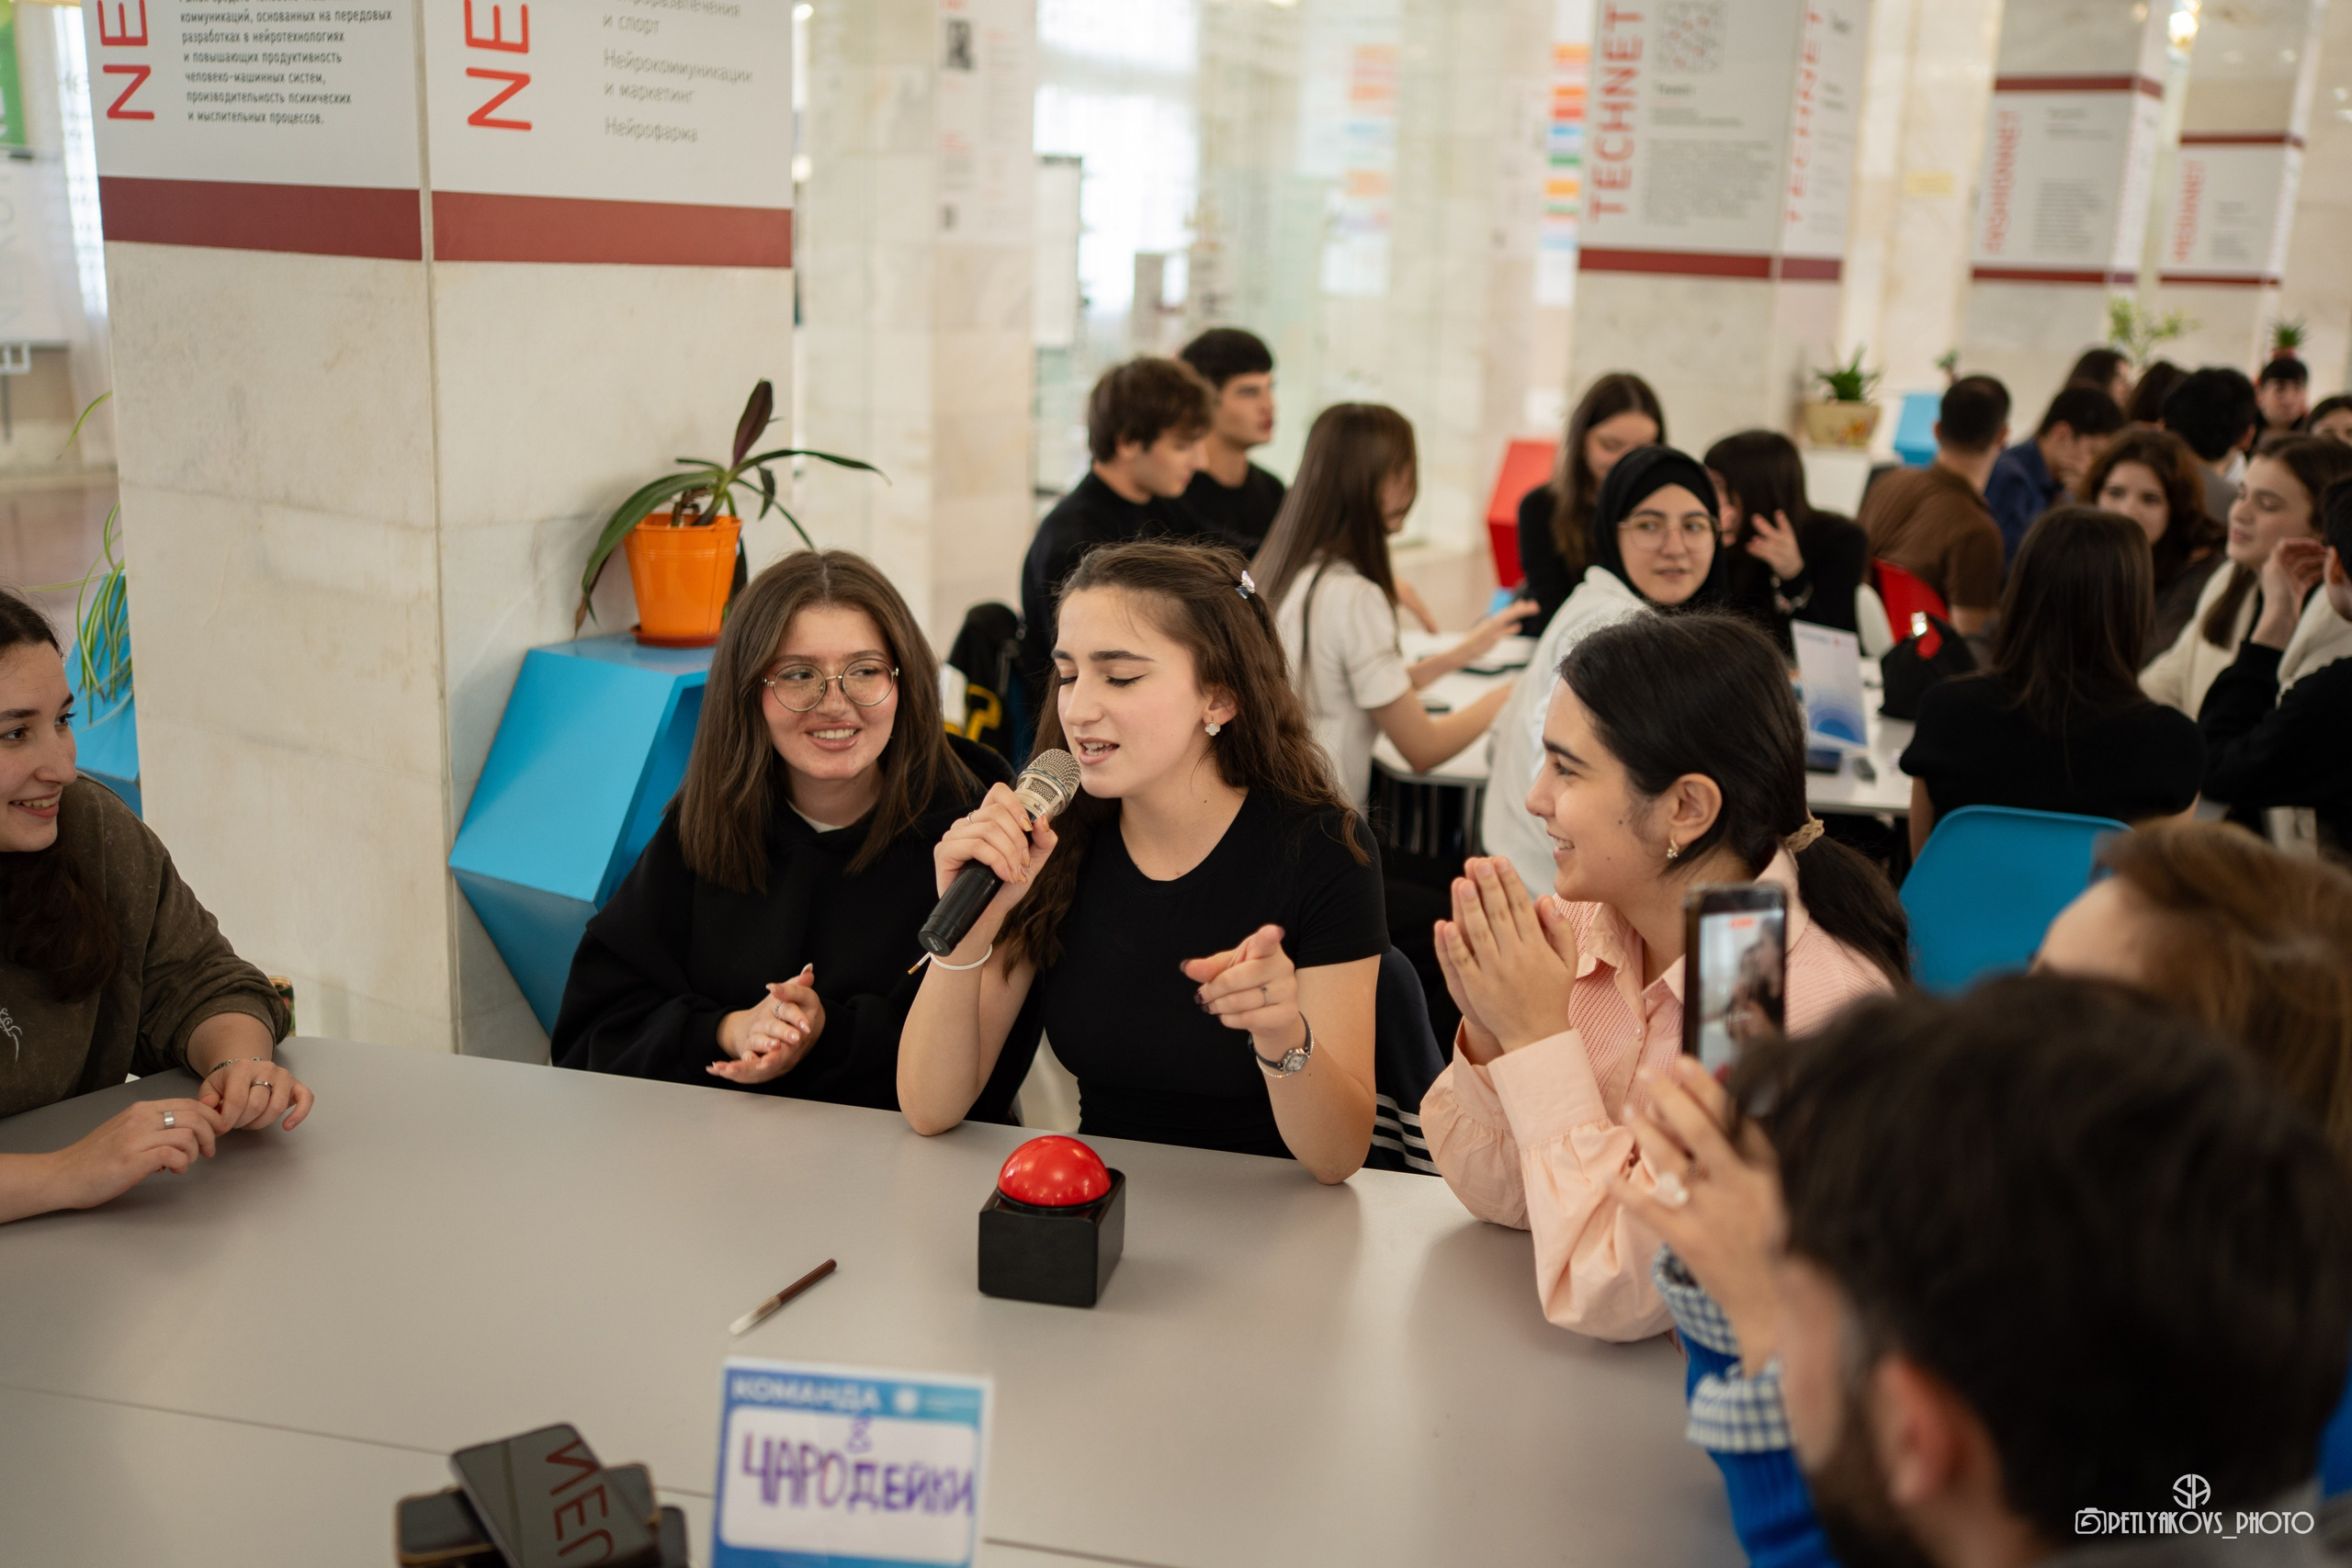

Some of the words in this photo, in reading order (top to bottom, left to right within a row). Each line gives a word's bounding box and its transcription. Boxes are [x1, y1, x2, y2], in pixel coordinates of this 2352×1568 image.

[180, 8, 254, 25] коммуникаций,
[256, 12, 315, 23] основанных
[320, 11, 331, 22] на
[334, 10, 392, 24] передовых
[603, 14, 613, 28] и
[617, 15, 660, 36] спорт
[182, 29, 241, 45] разработках
[243, 32, 249, 42] в
[253, 28, 345, 44] нейротехнологиях
[184, 52, 189, 62] и
[193, 51, 259, 64] повышающих
[262, 51, 343, 66] продуктивность
[603, 47, 752, 84] Нейрокоммуникации
[185, 72, 286, 84] человеко-машинных
[288, 72, 326, 85] систем,
[187, 92, 286, 105] производительность
[288, 93, 352, 105] психических
[604, 83, 614, 96] и
[619, 84, 695, 103] маркетинг
[187, 111, 194, 121] и
[198, 110, 266, 123] мыслительных
[269, 112, 324, 126] процессов.
[1588, 4, 1645, 223] TECHNET
[605, 115, 698, 143] Нейрофарма
[730, 1377, 882, 1413] КОМАНДА
[742, 1430, 975, 1515] ЧАРОДЕЙКИ
